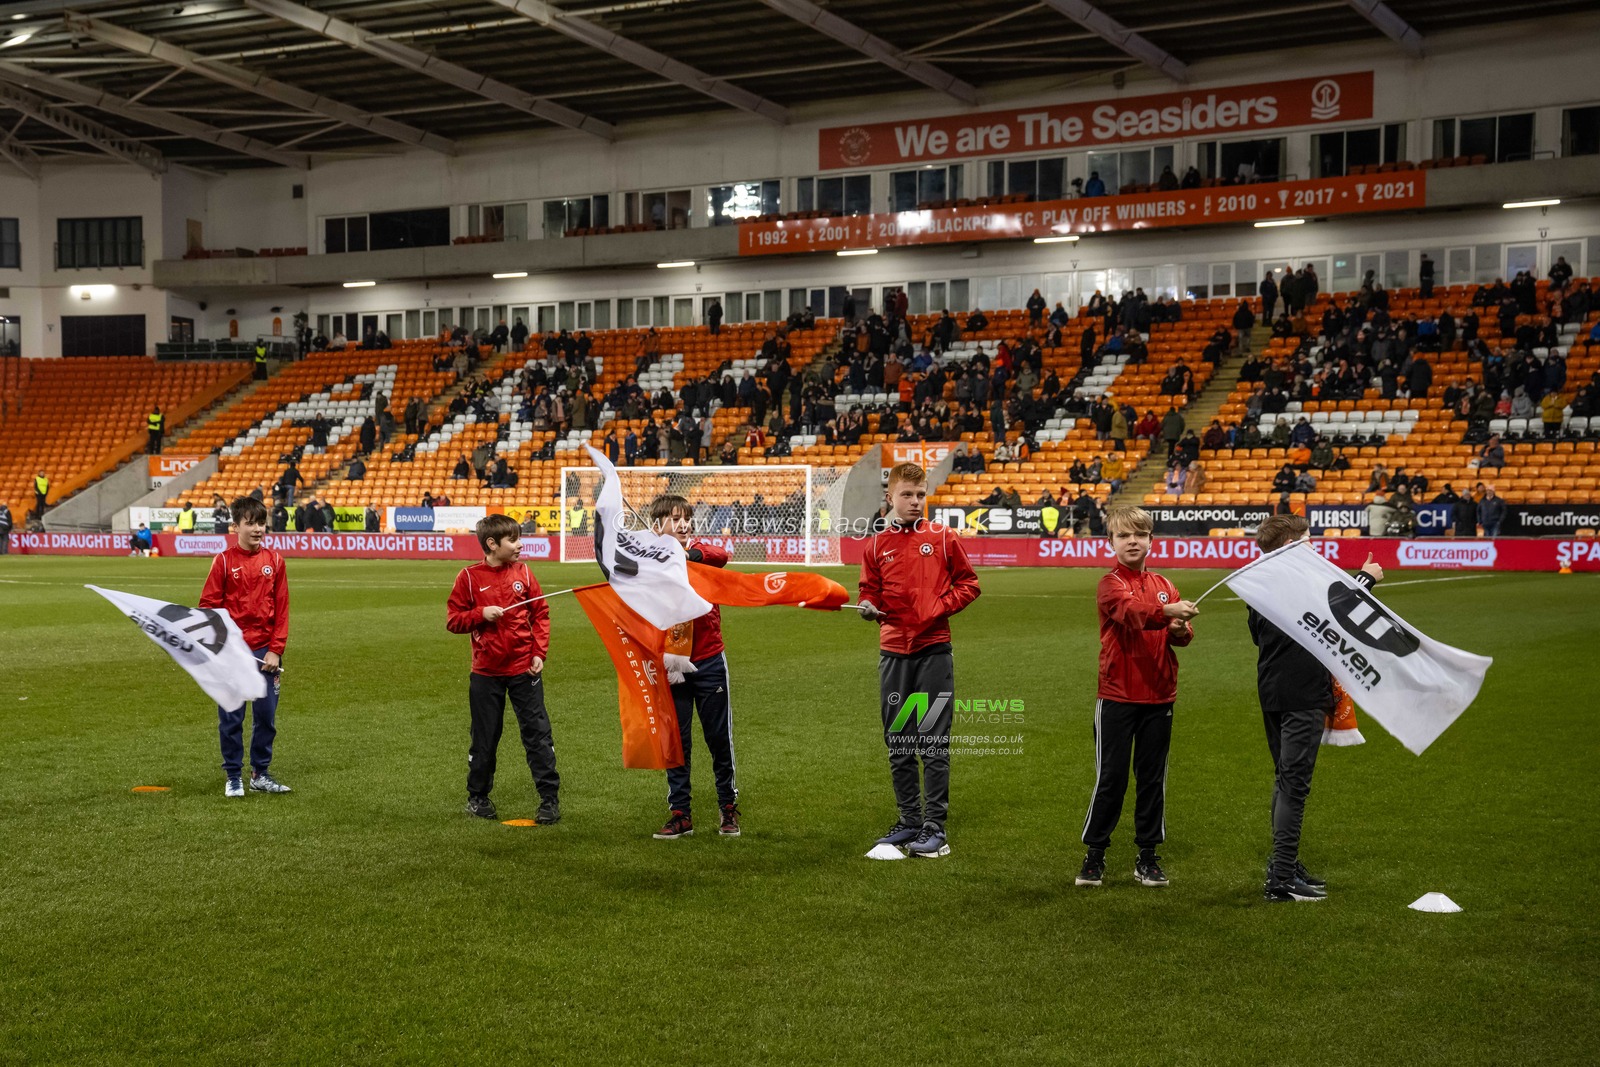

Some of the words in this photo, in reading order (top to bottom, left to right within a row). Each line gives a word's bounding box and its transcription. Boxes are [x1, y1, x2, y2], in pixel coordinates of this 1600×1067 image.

[894, 124, 948, 157] We
[956, 123, 1011, 153] are
[1017, 112, 1084, 147] The
[1091, 94, 1278, 139] Seasiders
[757, 231, 788, 246] 1992
[818, 226, 850, 242] 2001
[1042, 207, 1078, 225] PLAY
[1082, 205, 1111, 223] OFF
[1116, 200, 1186, 221] WINNERS
[1217, 194, 1258, 213] 2010
[1293, 188, 1334, 207] 2017
[1372, 181, 1415, 200] 2021
[883, 470, 889, 479] 9
[335, 513, 364, 523] OLDING
[396, 514, 434, 523] BRAVURA
[1017, 520, 1040, 530] Grap
[1310, 510, 1369, 528] PLEASUR
[1416, 509, 1447, 528] CH
[1519, 511, 1600, 527] TreadTrac
[21, 534, 50, 548] NO.1
[52, 534, 111, 549] DRAUGHT
[179, 538, 223, 550] Cruzcampo
[311, 536, 344, 551] NO.1
[346, 536, 416, 551] DRAUGHT
[417, 537, 454, 552] BEER
[1038, 540, 1116, 558] SPAIN'S
[1174, 541, 1264, 559] DRAUGH
[1405, 545, 1489, 562] Cruzcampo
[1556, 541, 1600, 562] SPA
[1297, 619, 1339, 657] SPORTS
[1340, 659, 1372, 692] MEDIA
[1302, 611, 1382, 687] eleven
[626, 650, 657, 735] SEASIDERS
